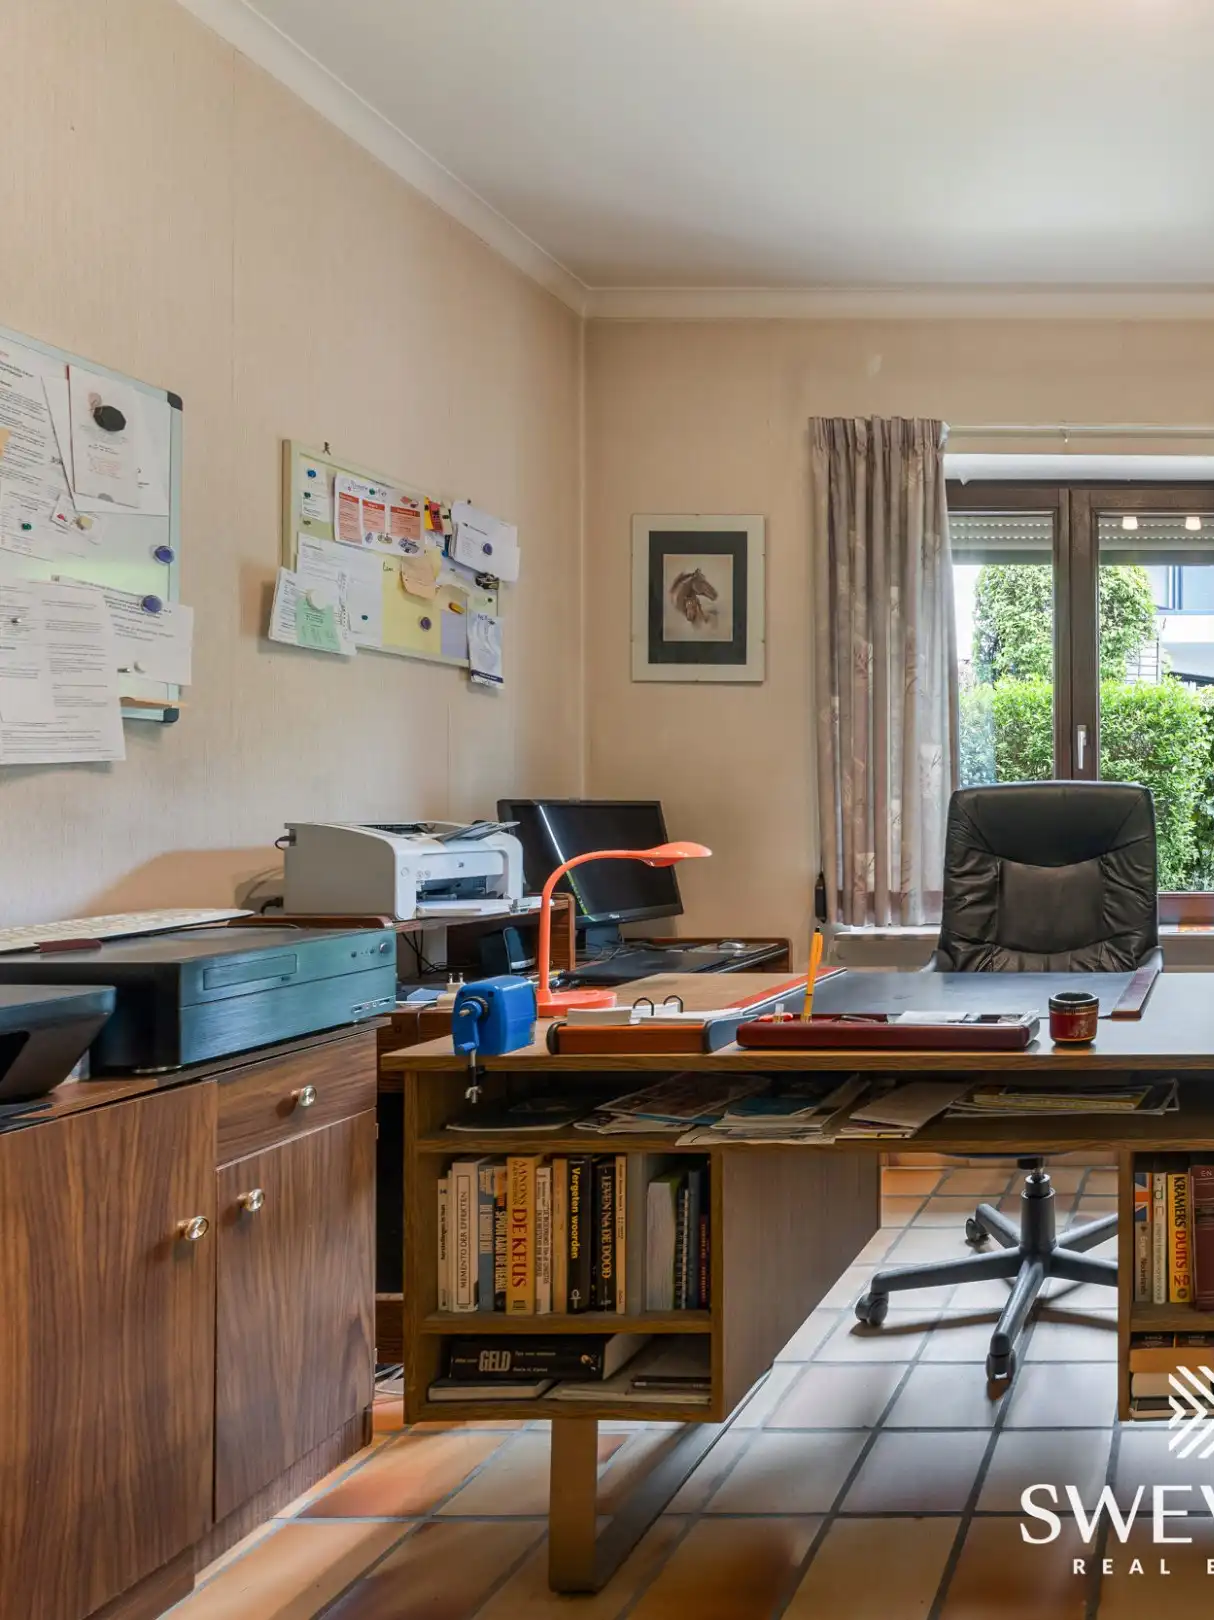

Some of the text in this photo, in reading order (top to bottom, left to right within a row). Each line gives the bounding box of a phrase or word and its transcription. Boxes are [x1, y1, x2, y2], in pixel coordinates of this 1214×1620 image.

[511, 1208, 528, 1234] DE
[570, 1167, 581, 1259] Vergeten woorden
[1173, 1176, 1187, 1228] KRAMERS
[460, 1232, 468, 1247] DER
[494, 1210, 506, 1235] SPION
[601, 1175, 612, 1279] LEVEN NA DE DOOD
[494, 1236, 506, 1255] AAN
[511, 1237, 528, 1288] KEUS
[1175, 1230, 1188, 1269] DUITS
[460, 1248, 468, 1288] MEMENTO
[478, 1350, 512, 1372] GELD
